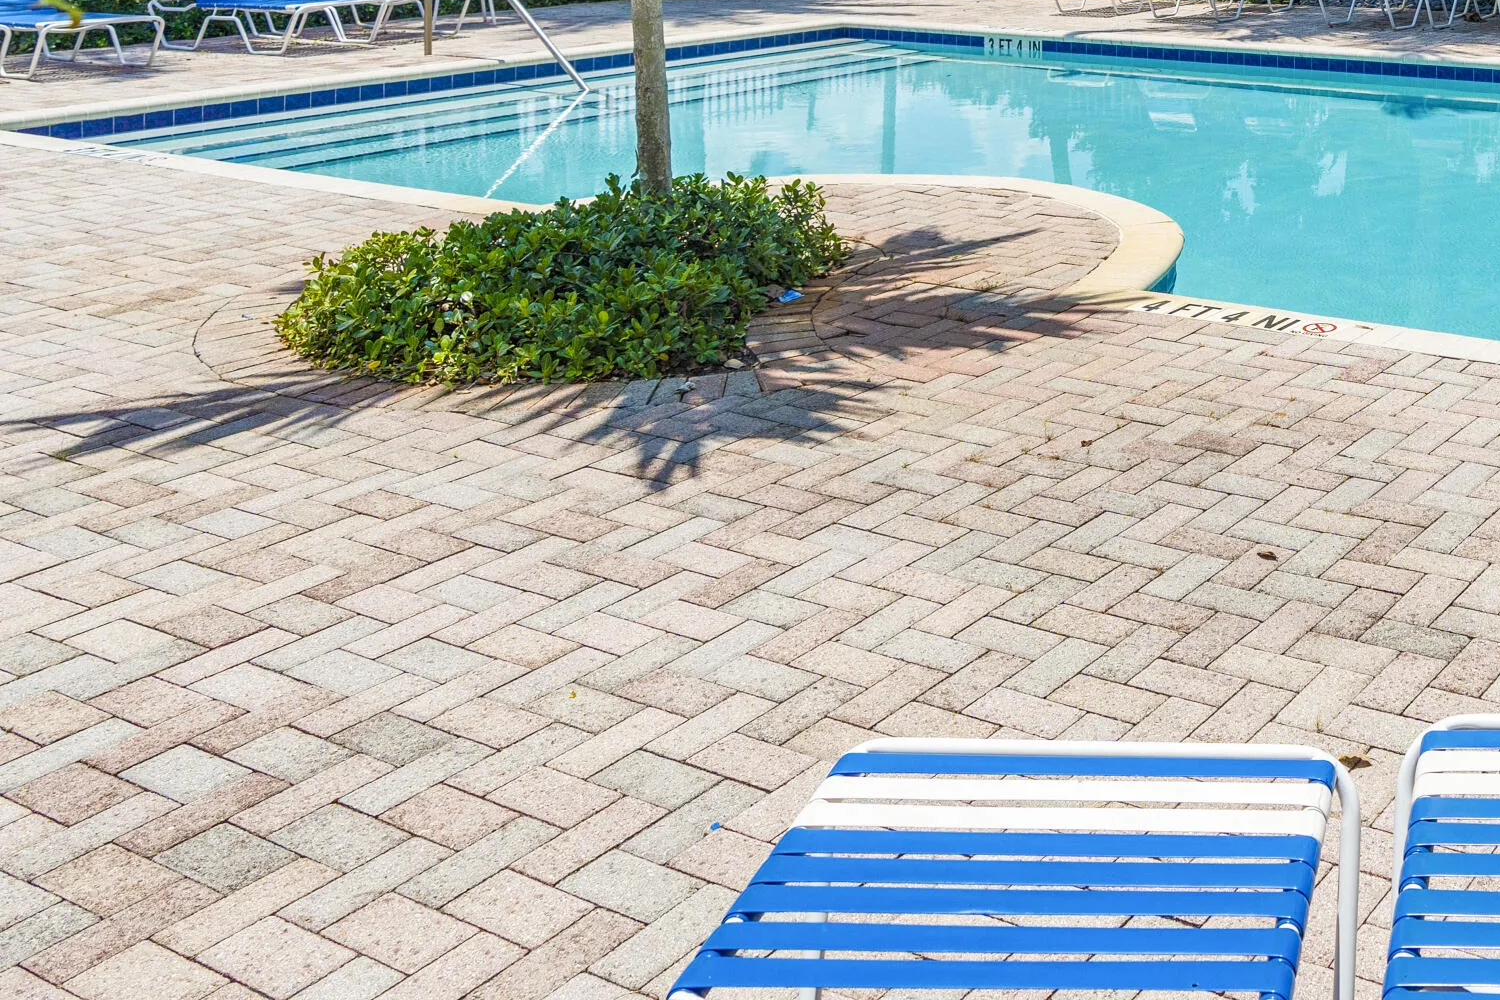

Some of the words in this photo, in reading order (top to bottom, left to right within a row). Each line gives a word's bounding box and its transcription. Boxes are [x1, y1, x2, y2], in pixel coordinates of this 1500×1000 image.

[988, 38, 995, 50] 3
[998, 38, 1013, 51] FT
[1016, 39, 1023, 51] 4
[1028, 40, 1041, 52] IN
[1141, 300, 1171, 311] 4
[1168, 303, 1222, 318] FT
[1221, 311, 1250, 323] 4
